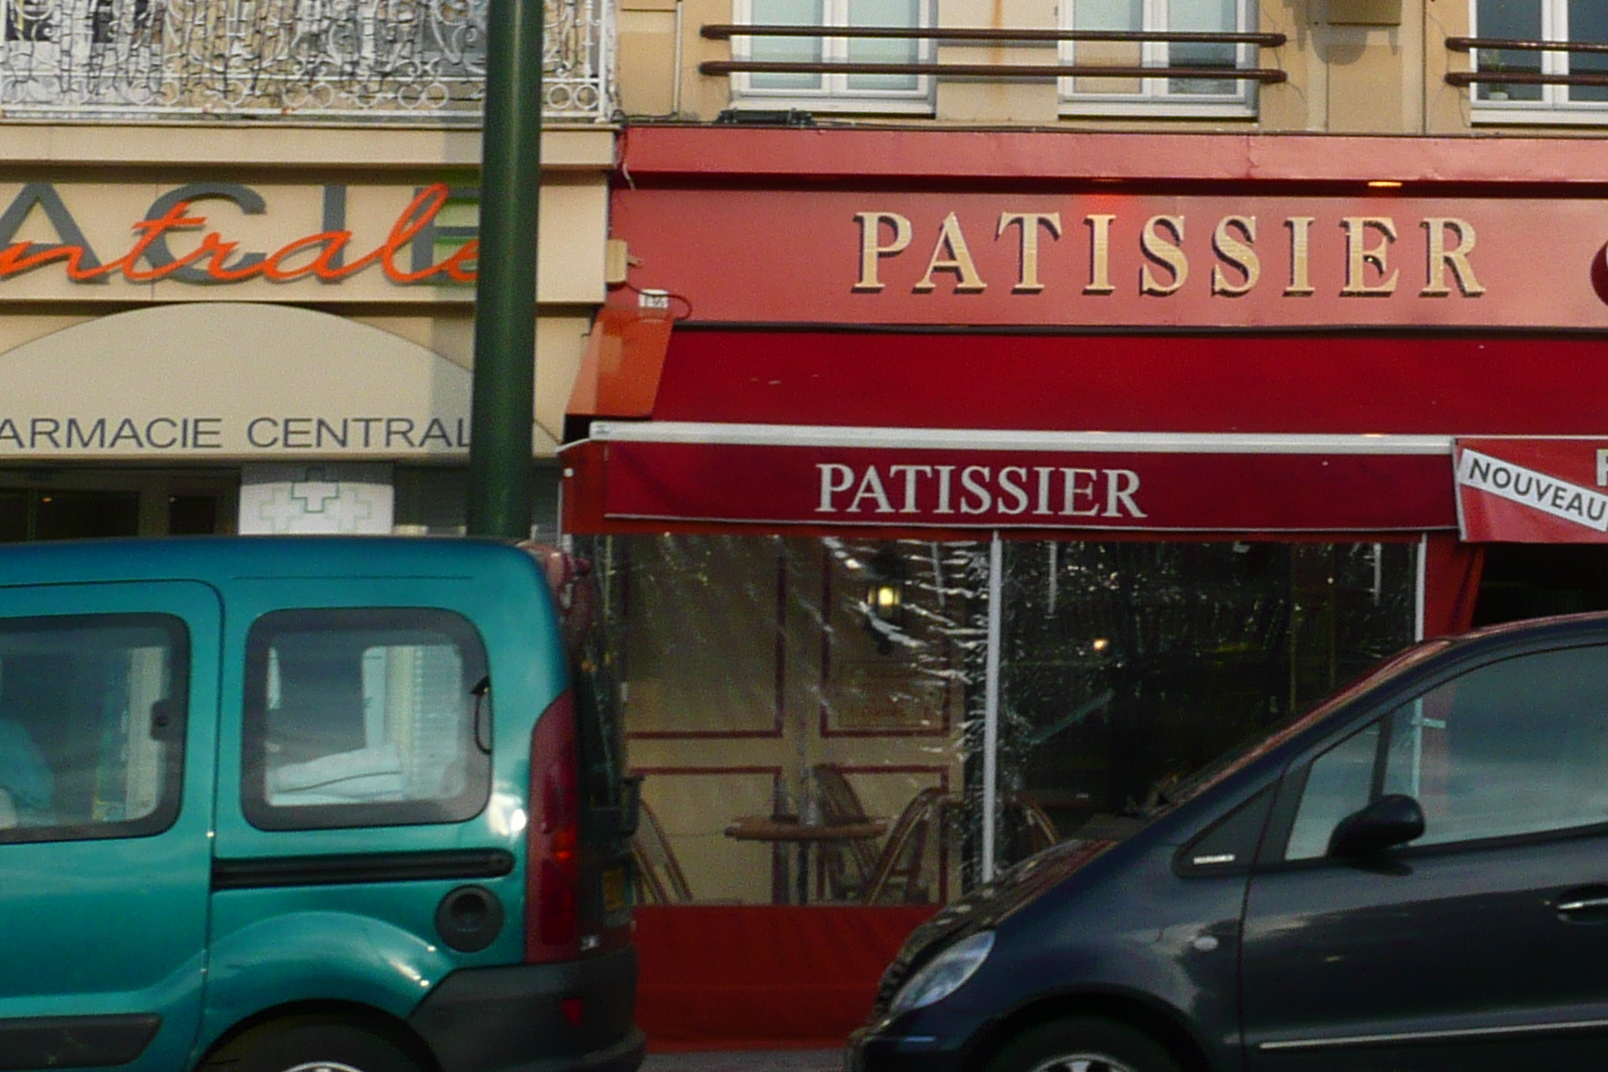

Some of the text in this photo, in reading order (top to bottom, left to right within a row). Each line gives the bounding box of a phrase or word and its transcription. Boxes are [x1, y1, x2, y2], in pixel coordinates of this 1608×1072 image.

[852, 211, 1486, 297] PATISSIER
[0, 417, 222, 448] ARMACIE
[815, 463, 1147, 518] PATISSIER
[1468, 457, 1608, 521] NOUVEAU
